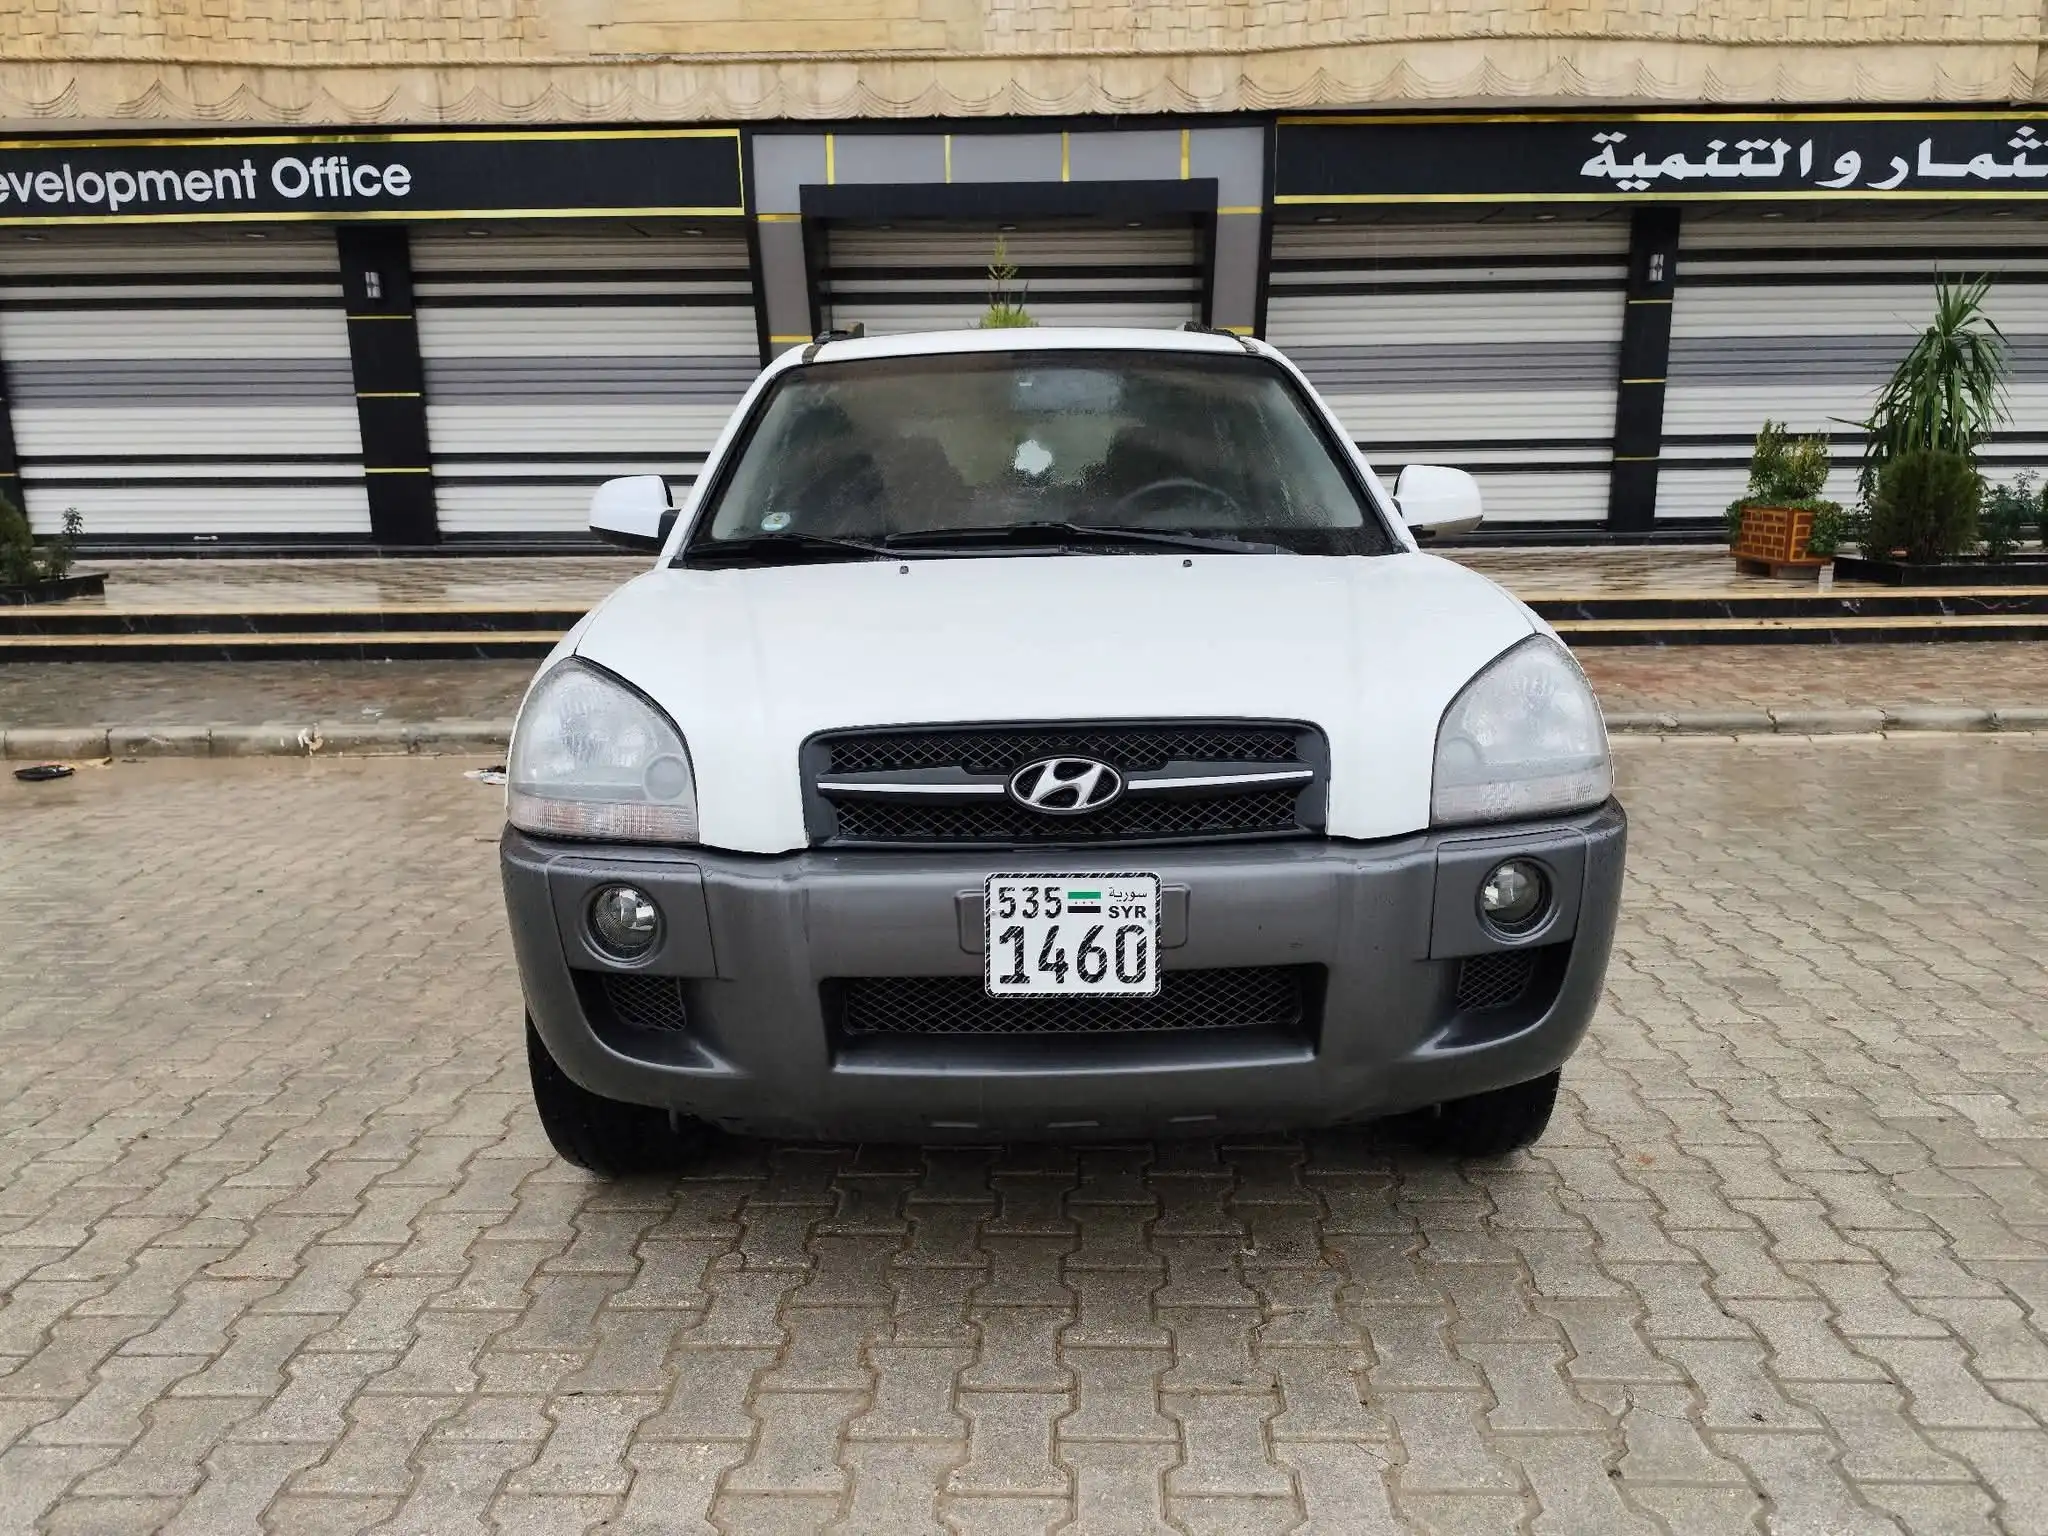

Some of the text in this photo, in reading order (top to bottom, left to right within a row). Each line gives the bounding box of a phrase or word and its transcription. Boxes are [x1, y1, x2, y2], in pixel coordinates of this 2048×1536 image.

[1580, 125, 2048, 191] ثمار والتنمية
[271, 156, 412, 198] Office
[998, 886, 1062, 919] 535
[1108, 886, 1148, 902] سورية
[1108, 905, 1147, 919] SYR
[999, 924, 1148, 984] 1460
